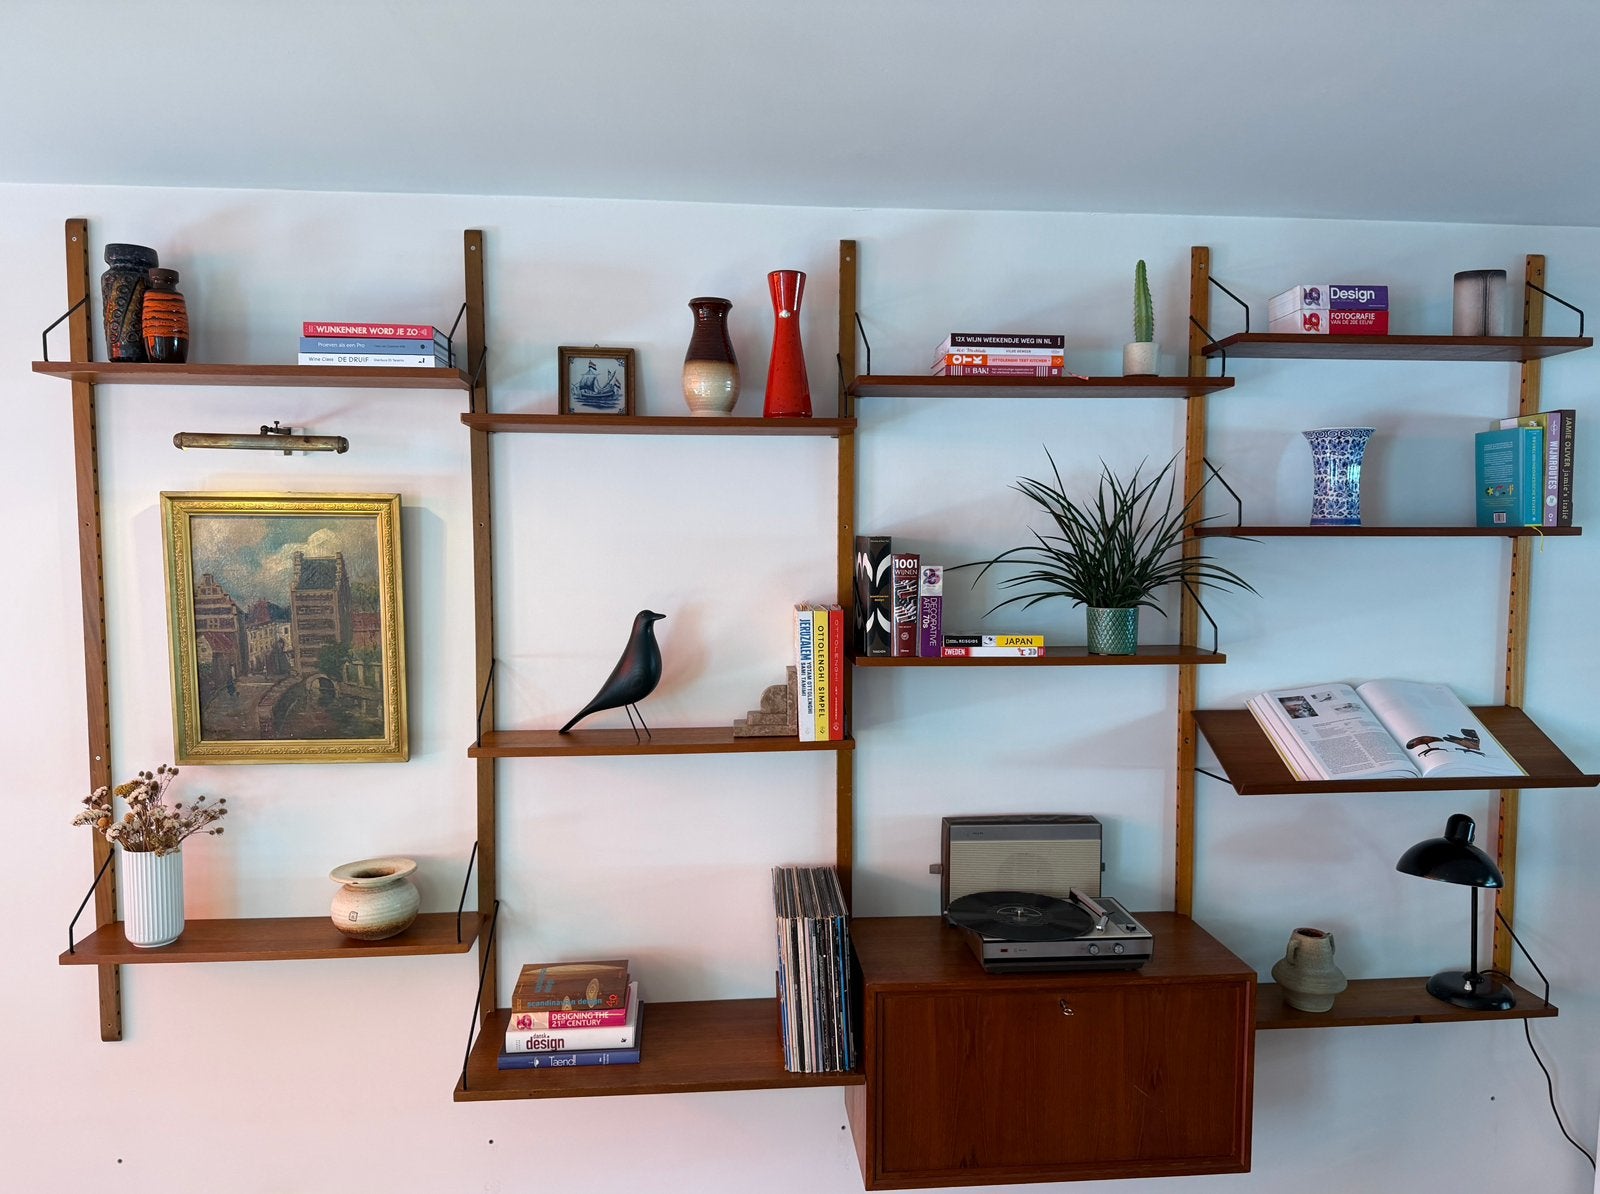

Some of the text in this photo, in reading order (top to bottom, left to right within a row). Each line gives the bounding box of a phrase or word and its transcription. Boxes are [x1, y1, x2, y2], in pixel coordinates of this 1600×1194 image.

[1330, 287, 1376, 303] Design
[1330, 312, 1376, 320] FOTOGRAFIE
[369, 326, 394, 336] WORD
[396, 328, 404, 336] JE
[406, 328, 418, 336] ZO
[1564, 442, 1572, 468] OLIVER
[1548, 440, 1559, 490] WIJNROUTES
[894, 559, 918, 568] 1001
[930, 597, 938, 646] DECORATIVE
[800, 619, 812, 661] JERUZALEM
[528, 999, 576, 1008] scandinavian
[552, 1012, 594, 1020] DESIGNING
[567, 1018, 602, 1026] CENTURY
[526, 1036, 566, 1051] design
